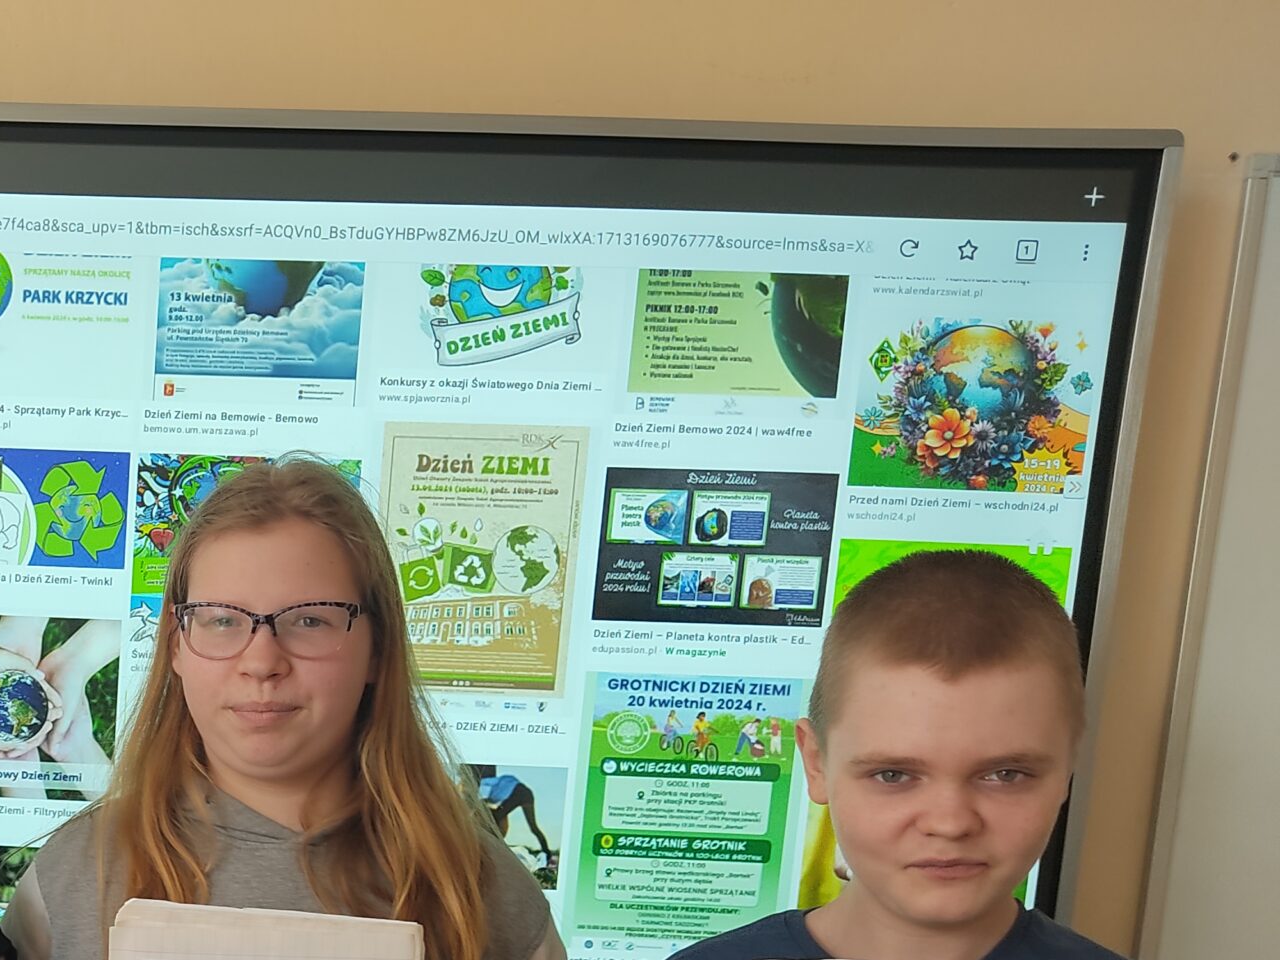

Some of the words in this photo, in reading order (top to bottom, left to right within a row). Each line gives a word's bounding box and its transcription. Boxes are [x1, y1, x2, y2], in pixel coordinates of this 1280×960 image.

[1023, 245, 1031, 257] 1
[22, 289, 61, 304] PARK
[64, 290, 128, 306] KRZYCKI
[169, 291, 181, 305] 13
[184, 291, 233, 306] kwietnia
[446, 329, 506, 357] DZIEŃ
[510, 311, 570, 342] ZIEMI
[379, 376, 427, 389] Konkursy
[429, 379, 435, 387] z
[438, 377, 468, 390] okazji
[470, 377, 534, 392] Światowego
[536, 380, 559, 390] Dnia
[561, 380, 591, 391] Ziemi
[13, 404, 66, 418] Sprzątamy
[68, 406, 91, 416] Park
[144, 409, 171, 419] Dzień
[174, 410, 202, 420] Ziemi
[220, 411, 265, 422] Bemowie
[275, 413, 318, 423] Bemowo
[614, 421, 643, 432] Dzień
[645, 423, 675, 433] Ziemi
[678, 423, 723, 434] Bemowo
[725, 425, 752, 435] 2024
[761, 425, 812, 437] waw4free
[613, 438, 670, 450] waw4free.pl
[415, 452, 474, 474] Dzień
[480, 455, 550, 476] ZIEMI
[1022, 456, 1063, 474] 15-19
[686, 470, 723, 487] Dzień
[724, 472, 757, 487] Ziemi
[848, 494, 879, 505] Przed
[880, 495, 908, 506] nami
[910, 496, 939, 507] Dzień
[941, 497, 971, 508] Ziemi
[984, 499, 1059, 514] wschodni24.pl
[846, 509, 916, 523] wschodni24.pl
[14, 573, 42, 583] Dzień
[44, 574, 72, 584] Ziemi
[80, 575, 112, 586] Twinkl
[593, 628, 621, 639] Dzień
[623, 629, 653, 640] Ziemi
[665, 630, 704, 641] Planeta
[707, 631, 740, 643] kontra
[743, 633, 777, 646] plastik
[675, 647, 726, 658] magazynie
[607, 677, 695, 693] GROTNICKI
[699, 678, 745, 695] DZIEŃ
[748, 682, 791, 696] ZIEMI
[627, 694, 645, 707] 20
[648, 694, 713, 712] kwietnia
[716, 698, 752, 710] 2024
[756, 702, 766, 711] r.
[455, 719, 487, 731] DZIEŃ
[488, 722, 518, 733] ZIEMI
[21, 768, 50, 781] Dzień
[51, 771, 82, 782] Ziemi
[619, 761, 686, 774] WYCIECZKA
[689, 763, 761, 778] ROWEROWA
[617, 834, 688, 852] SPRZĄTANIE
[691, 836, 747, 854] GROTNIK
